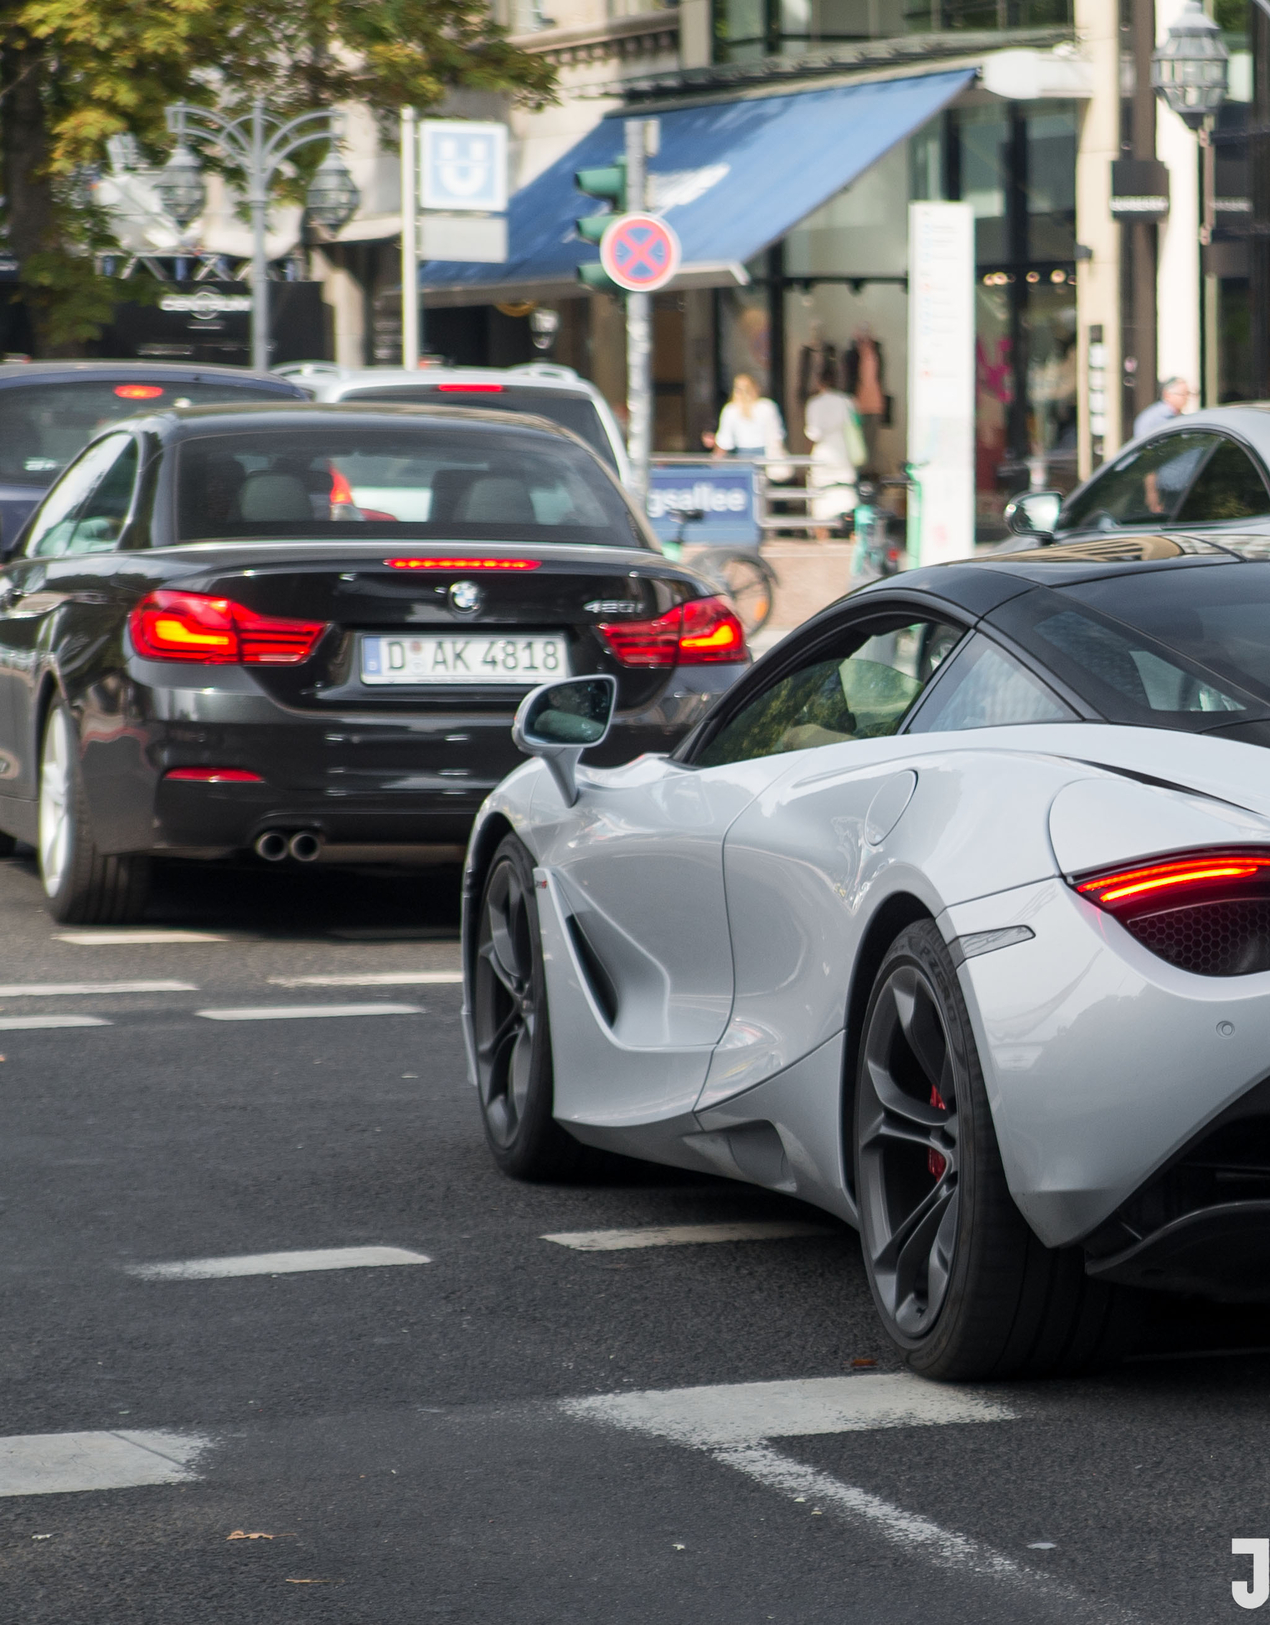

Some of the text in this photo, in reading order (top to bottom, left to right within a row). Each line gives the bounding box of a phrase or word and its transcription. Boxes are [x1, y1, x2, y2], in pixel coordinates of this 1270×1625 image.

[388, 641, 559, 671] D AK 4818
